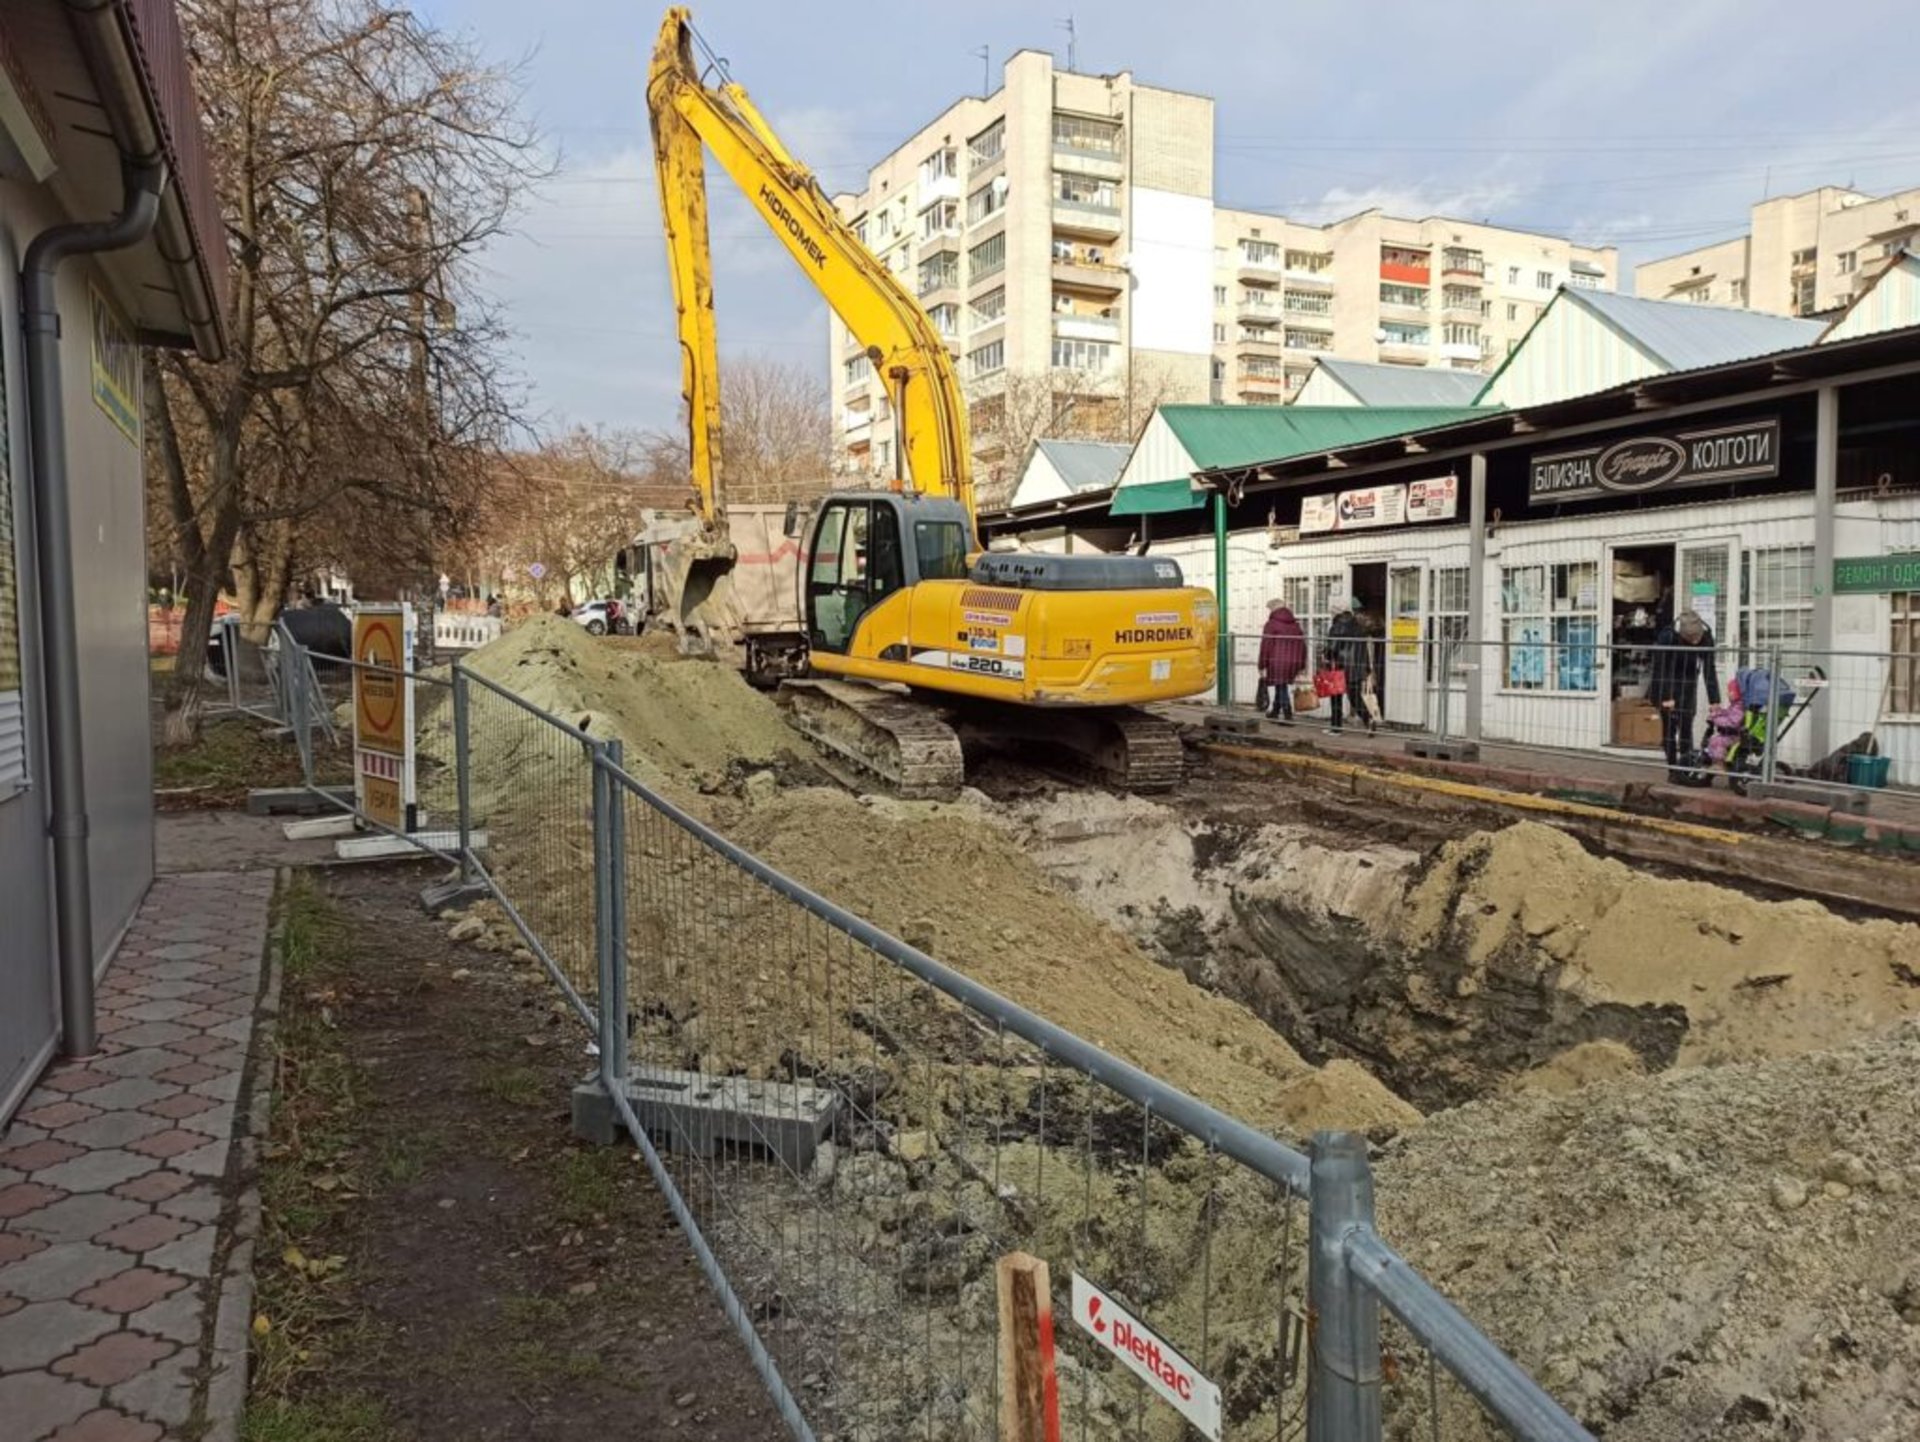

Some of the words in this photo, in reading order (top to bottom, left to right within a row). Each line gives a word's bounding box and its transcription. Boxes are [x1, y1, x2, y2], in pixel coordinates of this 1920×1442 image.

[1534, 459, 1593, 492] БІЛИЗНА
[1692, 432, 1770, 471] КОЛГОТИ
[1836, 564, 1888, 584] РЕМОНТ
[1114, 1319, 1191, 1401] plettac
